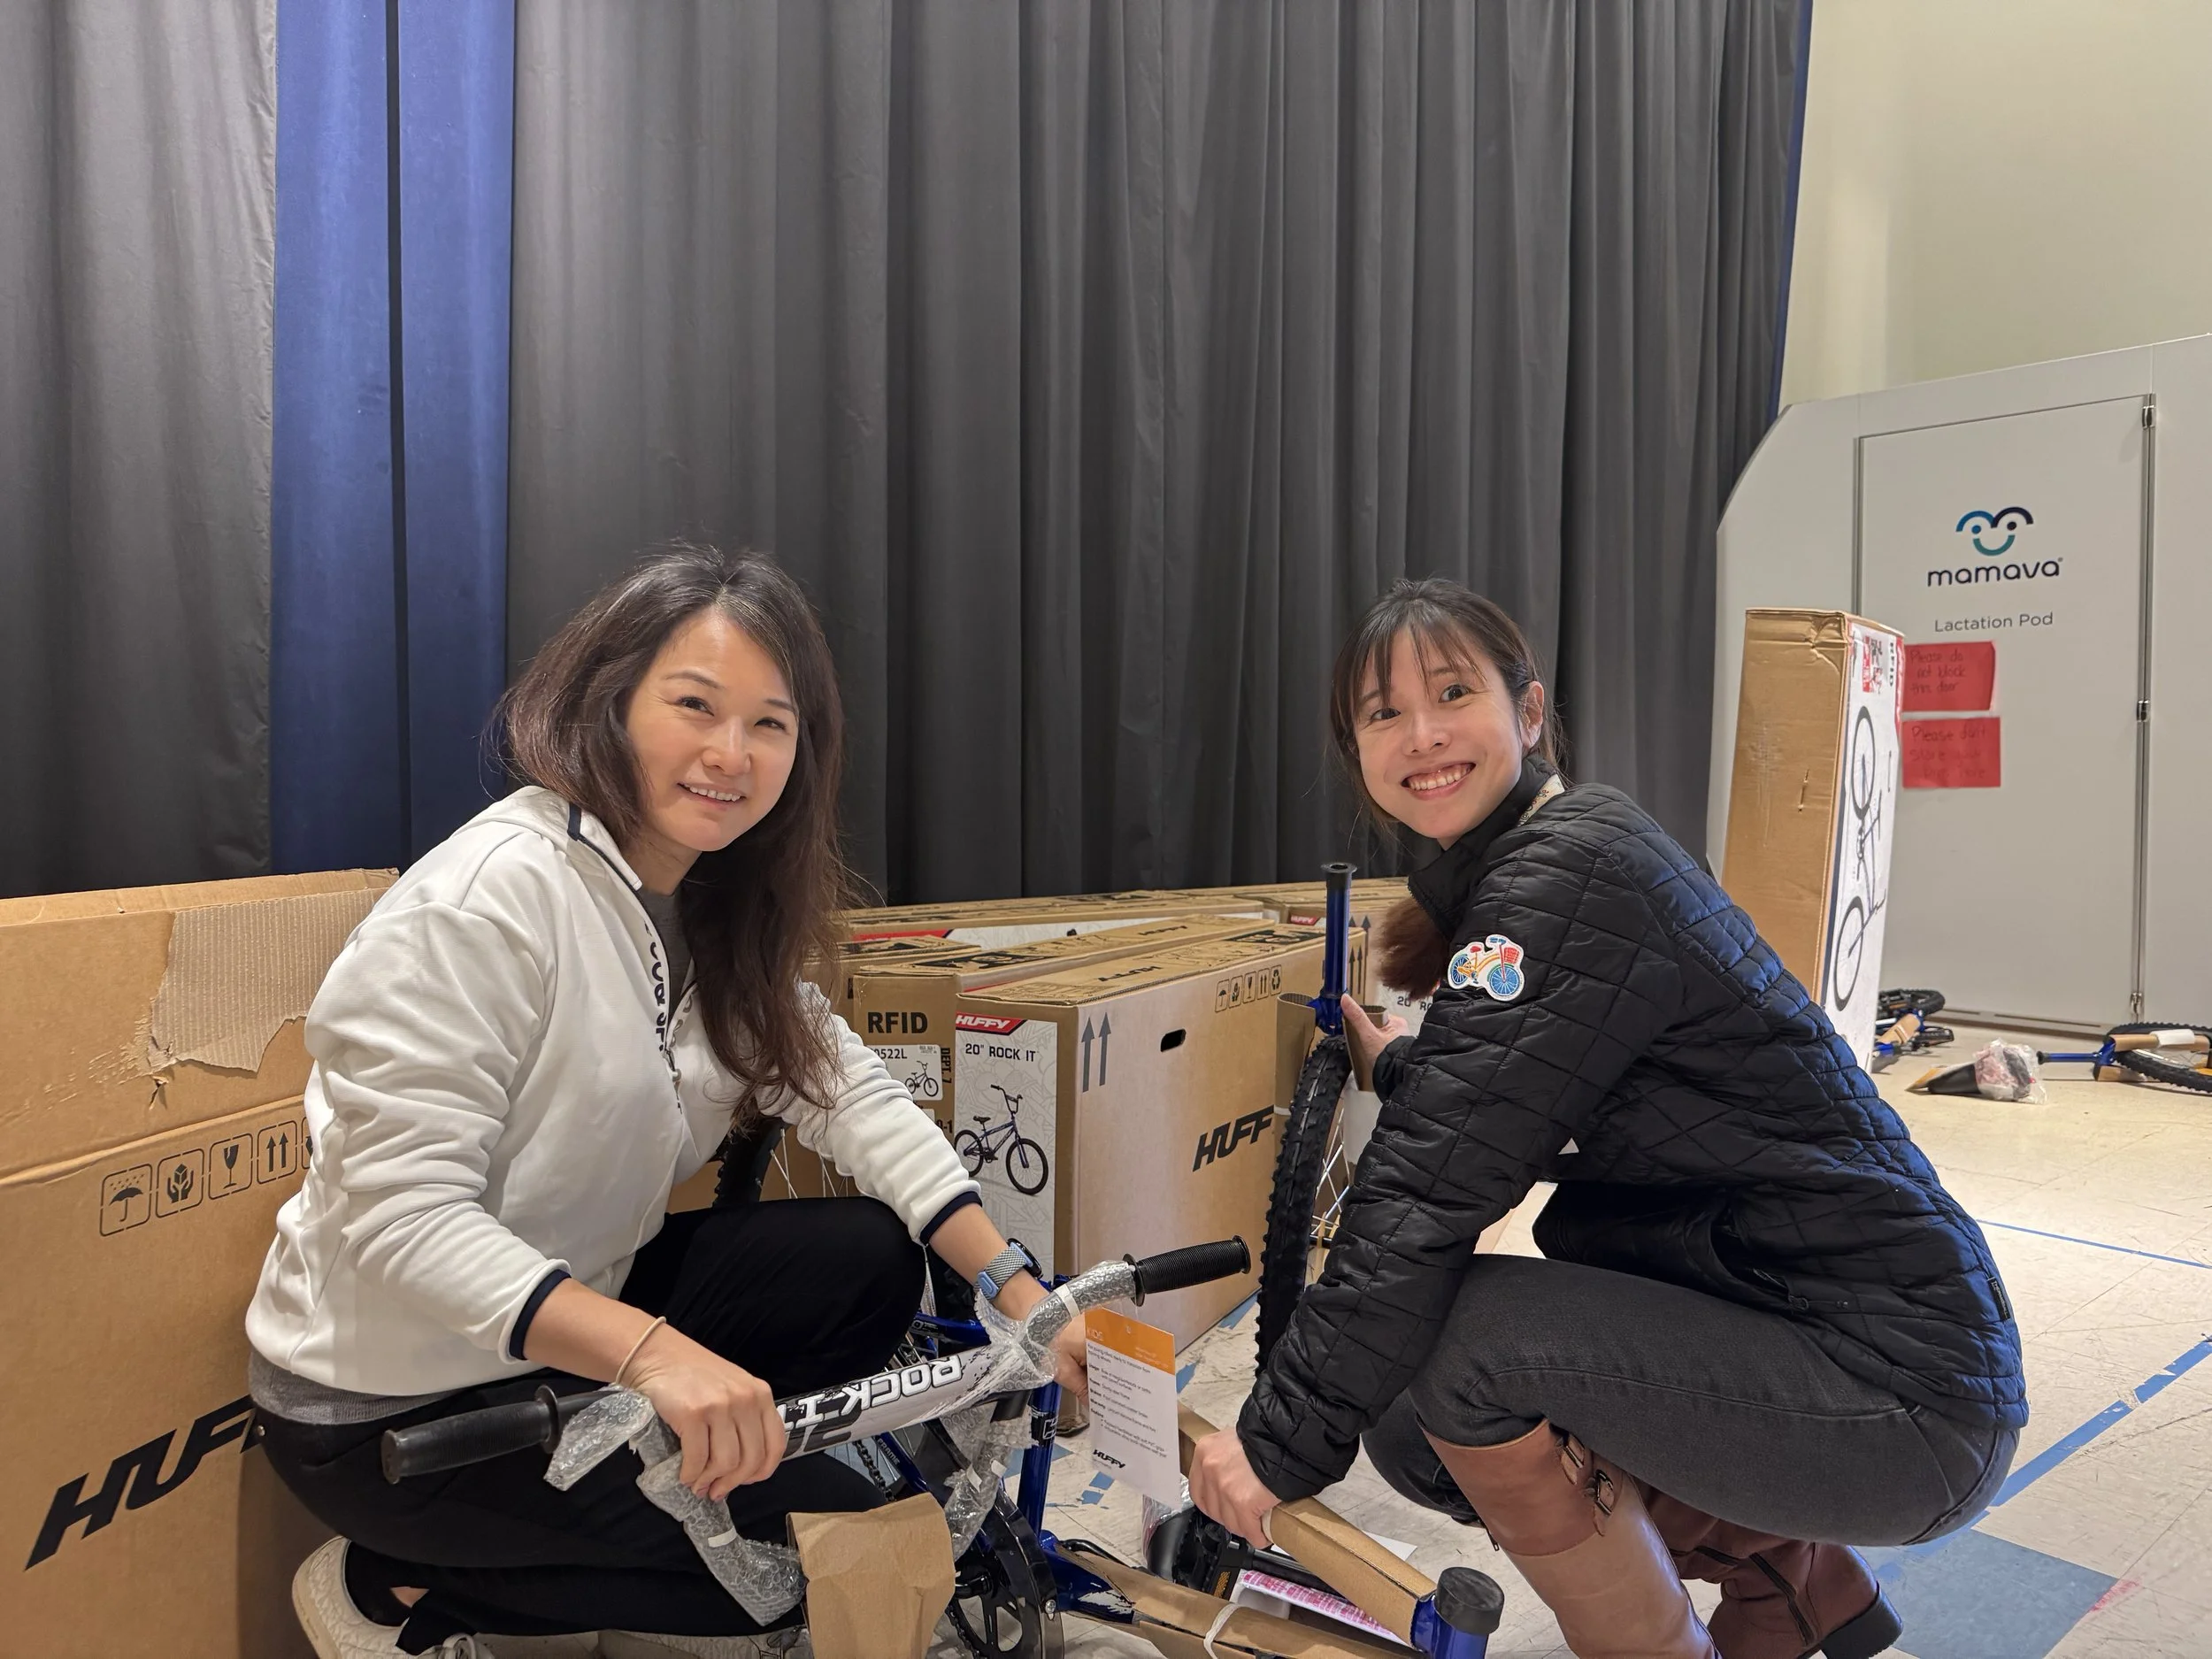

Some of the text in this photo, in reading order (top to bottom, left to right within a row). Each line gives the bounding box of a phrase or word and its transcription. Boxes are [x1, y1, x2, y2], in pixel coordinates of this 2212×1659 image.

[1927, 560, 2060, 588] mamava
[1934, 611, 2054, 633] Lactation Pod
[867, 1011, 928, 1033] RFID
[956, 1015, 1010, 1029] HUFFY
[965, 1042, 1036, 1062] 20" ROCK IT
[1093, 1448, 1125, 1469] HUFFY
